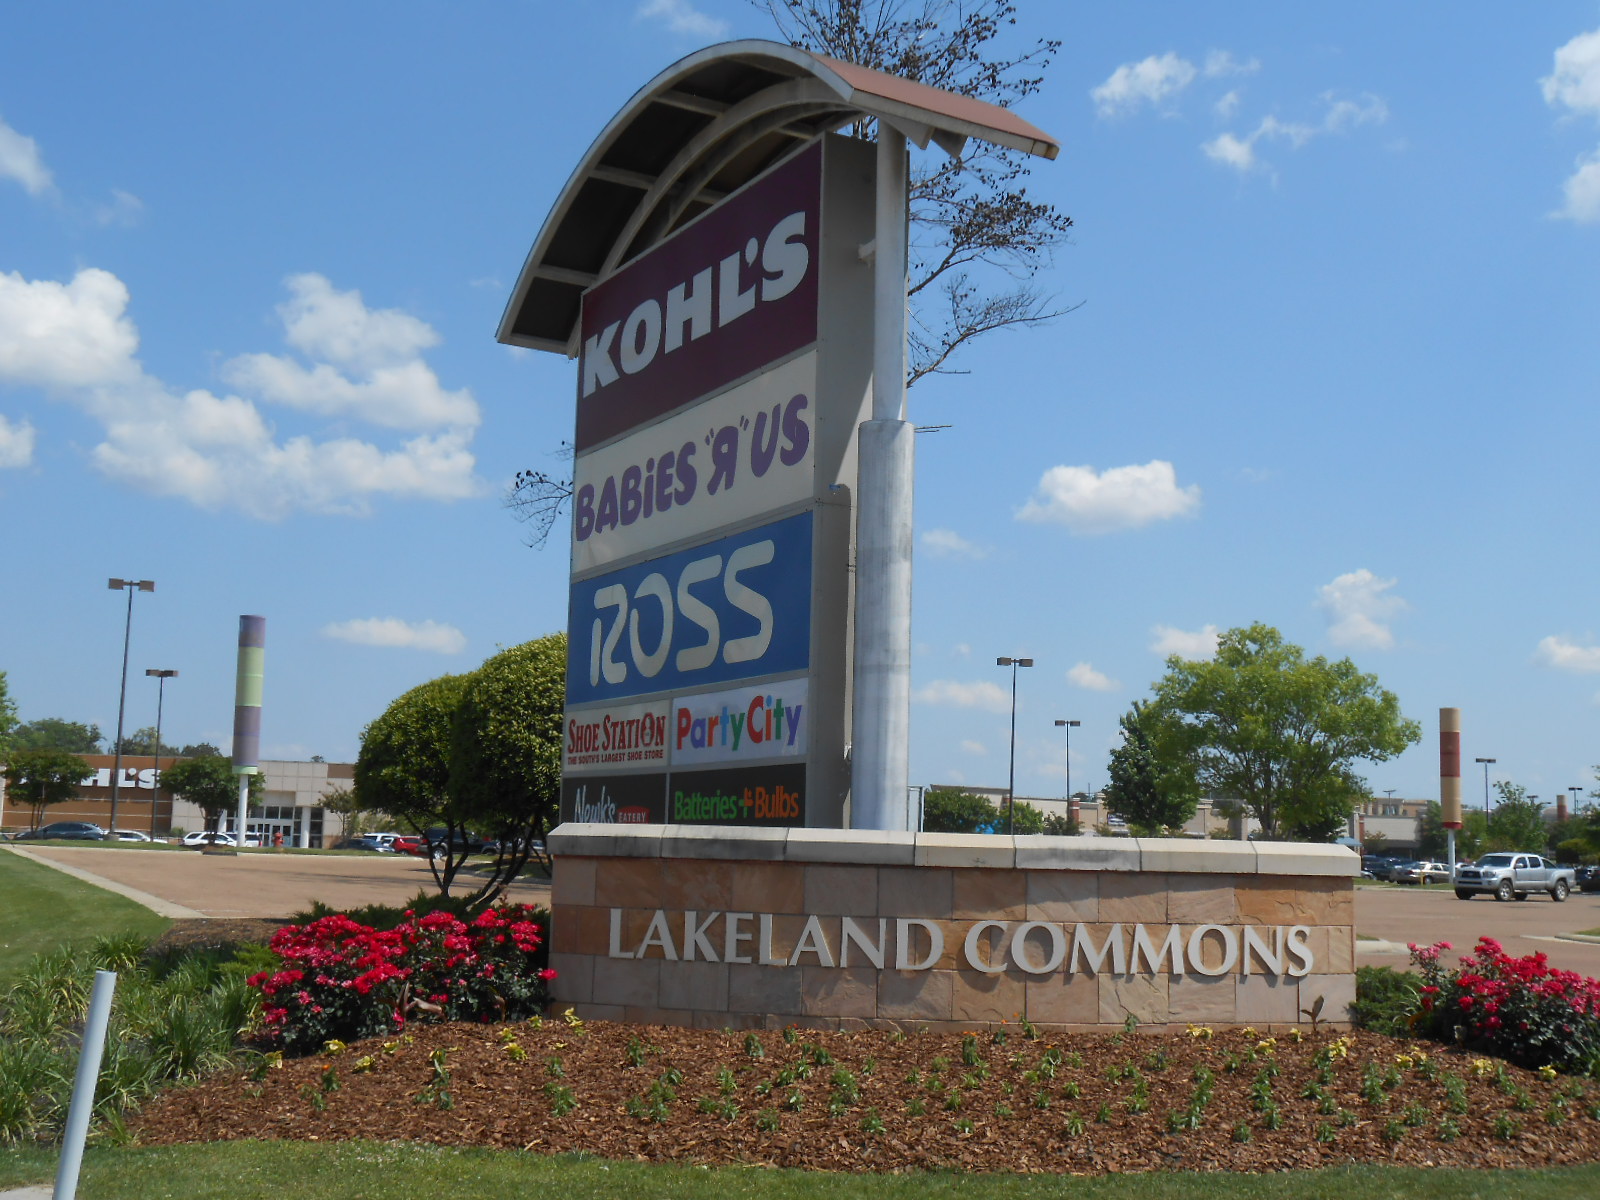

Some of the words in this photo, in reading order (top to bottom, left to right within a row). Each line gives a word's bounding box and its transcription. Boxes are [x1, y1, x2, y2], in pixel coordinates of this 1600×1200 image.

[583, 211, 809, 399] KOHL'S
[751, 394, 809, 478] US
[590, 539, 775, 687] ROSS
[568, 719, 600, 754] SHOE
[602, 712, 667, 751] STATION
[568, 756, 577, 765] THE
[578, 754, 600, 764] SOUTH'S
[601, 752, 626, 763] LARGEST
[627, 751, 642, 761] SHOE
[644, 749, 664, 760] STORE
[574, 785, 618, 823] Newk's
[618, 812, 647, 823] EATERY
[608, 907, 945, 971] LAKELAND
[964, 919, 1314, 977] COMMONS
